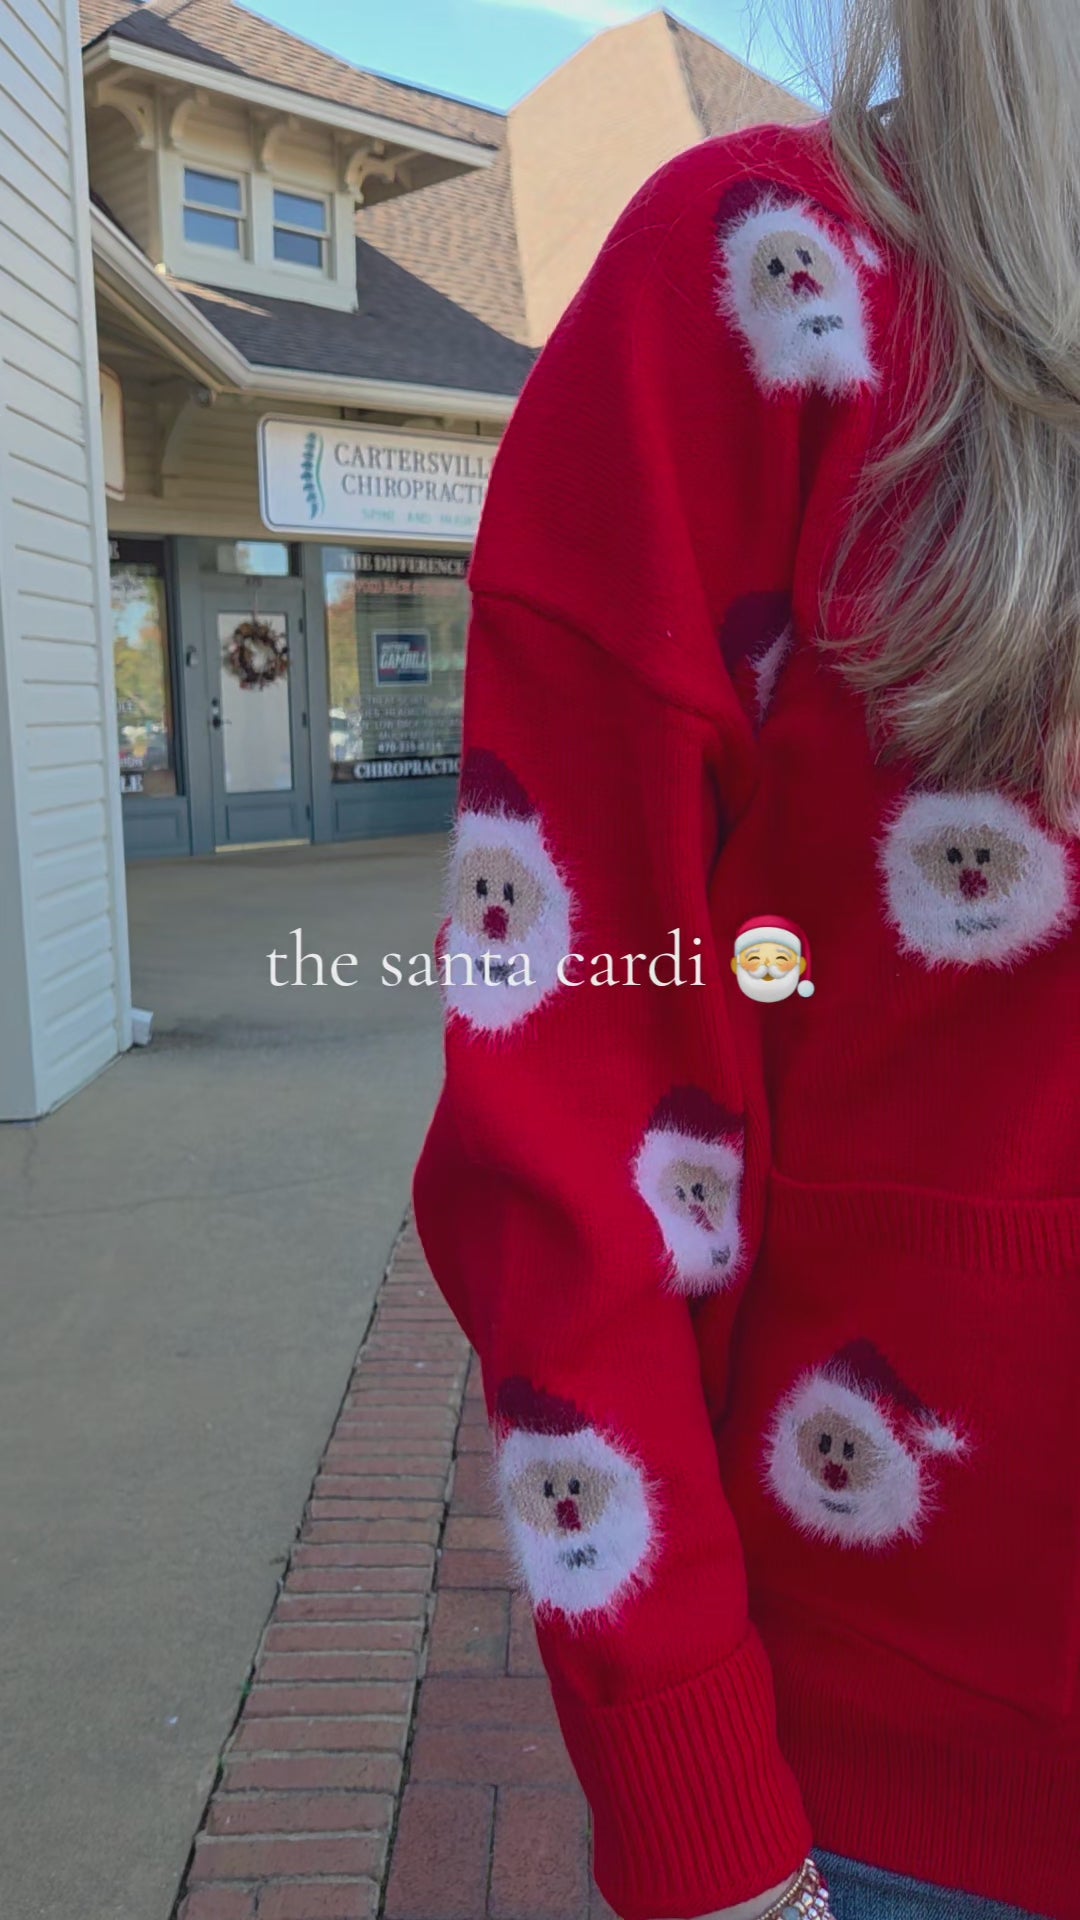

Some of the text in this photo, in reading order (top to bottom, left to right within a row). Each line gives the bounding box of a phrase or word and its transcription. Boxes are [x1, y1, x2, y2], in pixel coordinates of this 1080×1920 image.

[334, 441, 491, 479] CARTERSVILL
[342, 473, 485, 505] CHIROPRACTI
[342, 555, 465, 575] THE DIFFERENCE
